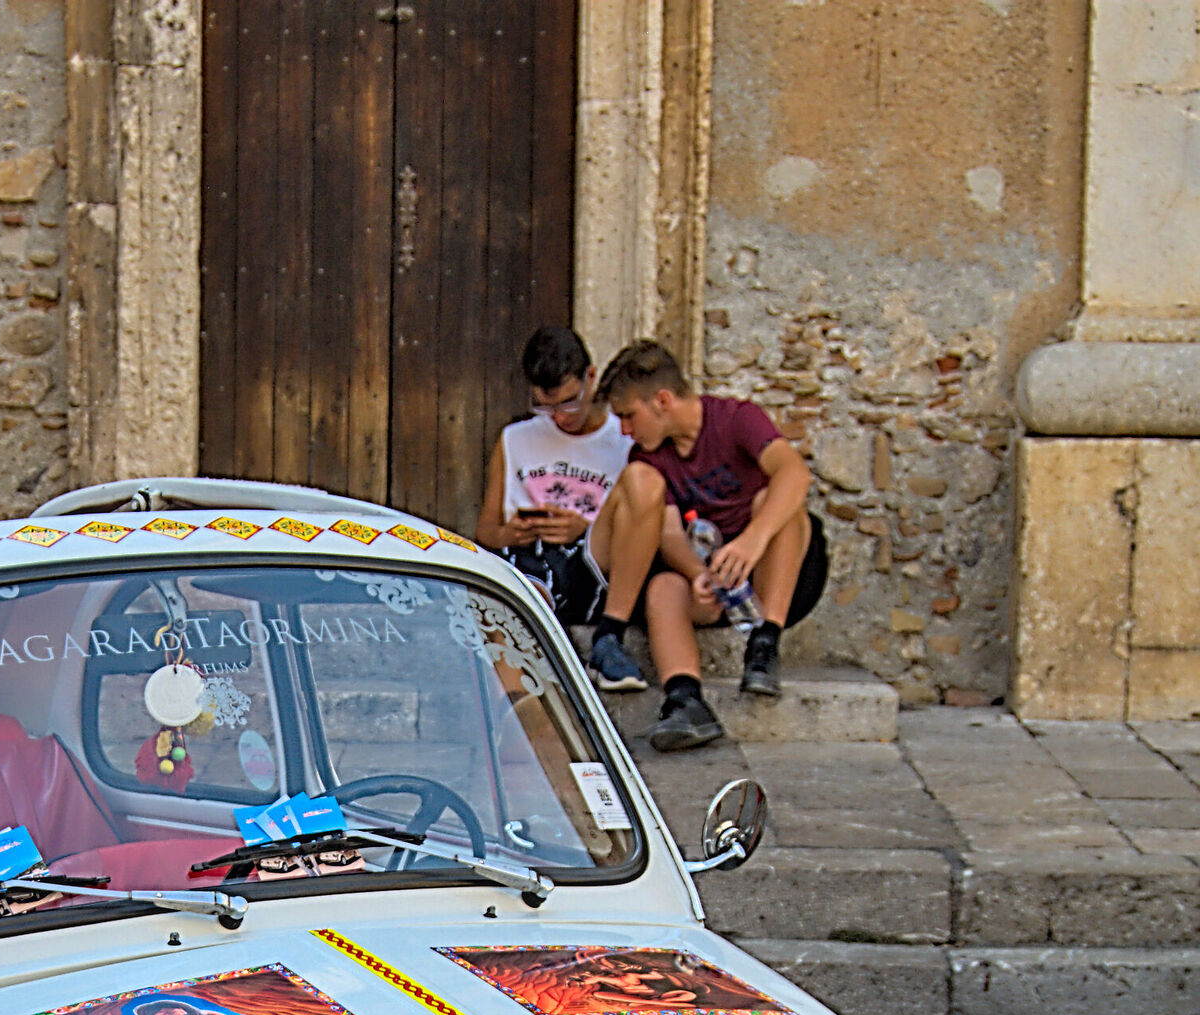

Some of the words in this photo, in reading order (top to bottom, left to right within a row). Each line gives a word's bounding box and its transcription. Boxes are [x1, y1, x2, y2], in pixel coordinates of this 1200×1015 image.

[517, 467, 547, 481] Los
[553, 460, 613, 490] Angele
[183, 617, 407, 649] TAORMINA
